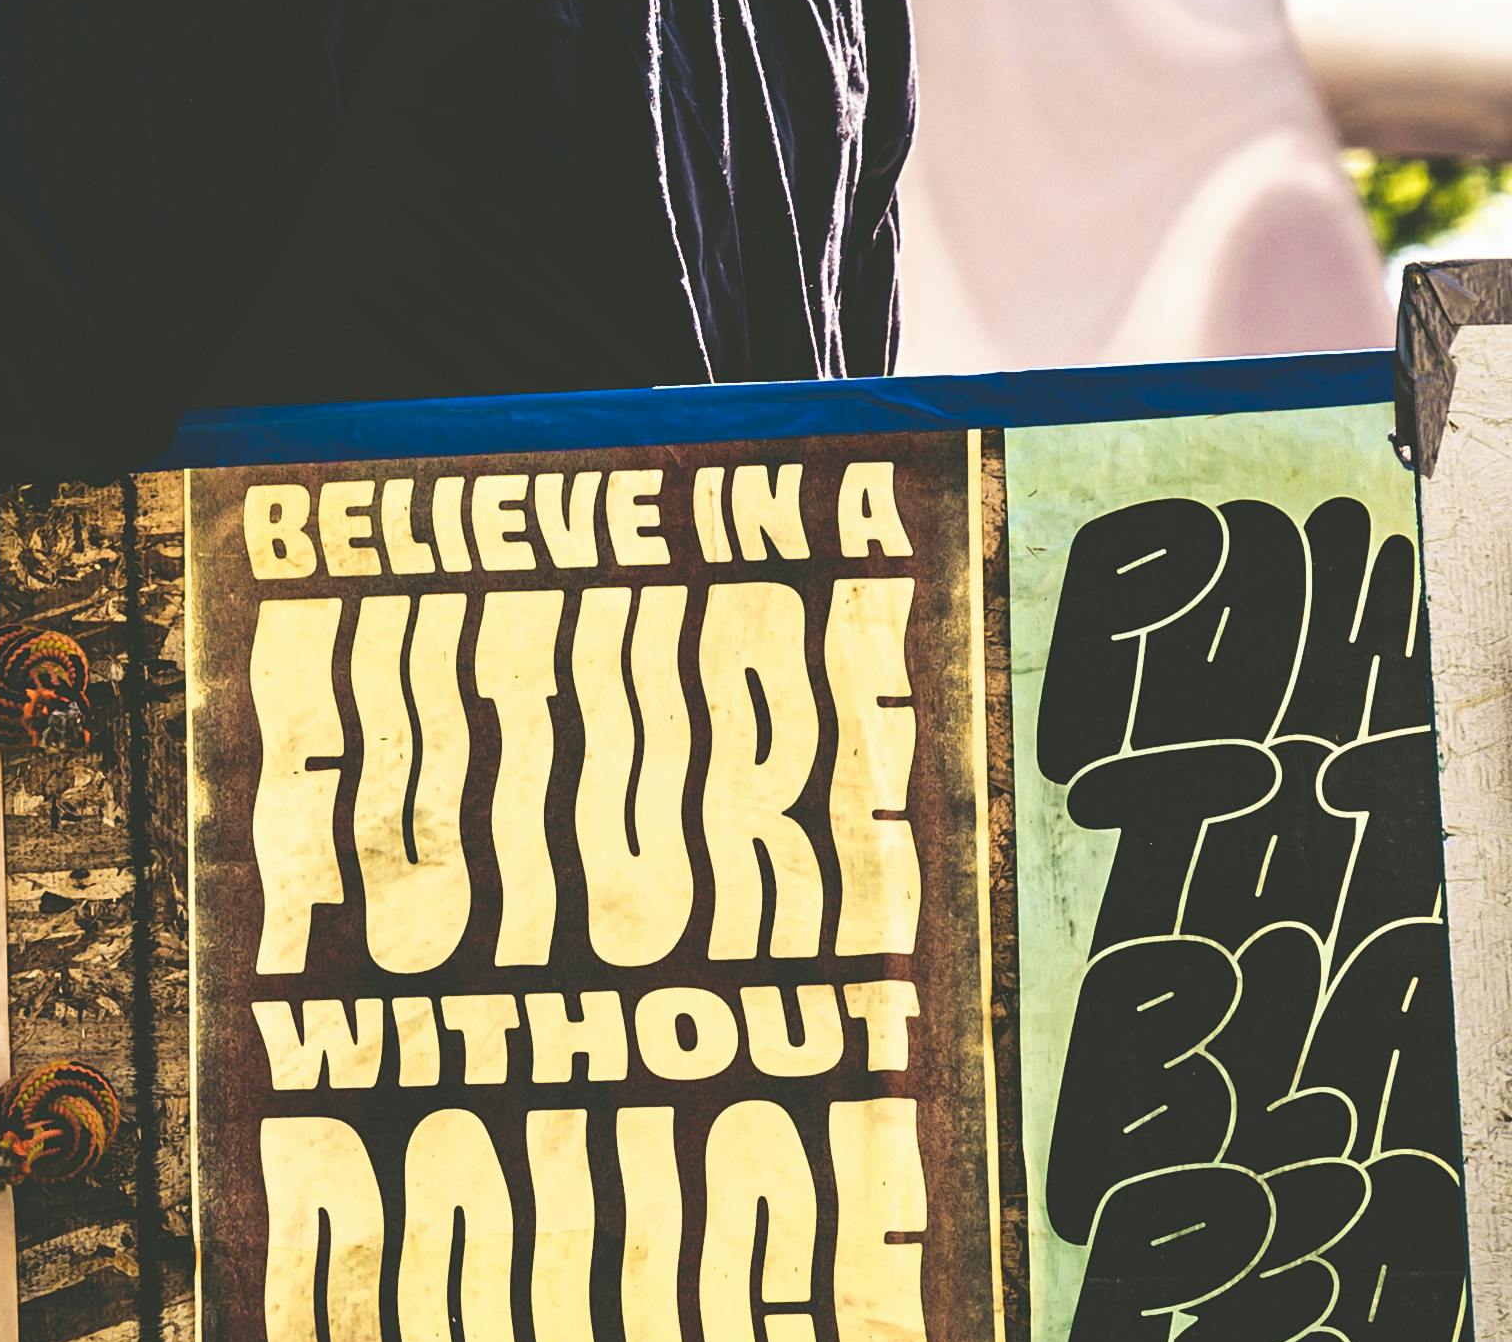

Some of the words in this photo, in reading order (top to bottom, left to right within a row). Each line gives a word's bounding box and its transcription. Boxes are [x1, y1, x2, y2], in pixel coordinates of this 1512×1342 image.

[243, 470, 670, 580] BELIEVE
[694, 464, 810, 562] IN
[838, 462, 913, 557] A
[250, 578, 921, 974] FUTURE
[252, 980, 920, 1090] WITHOUT
